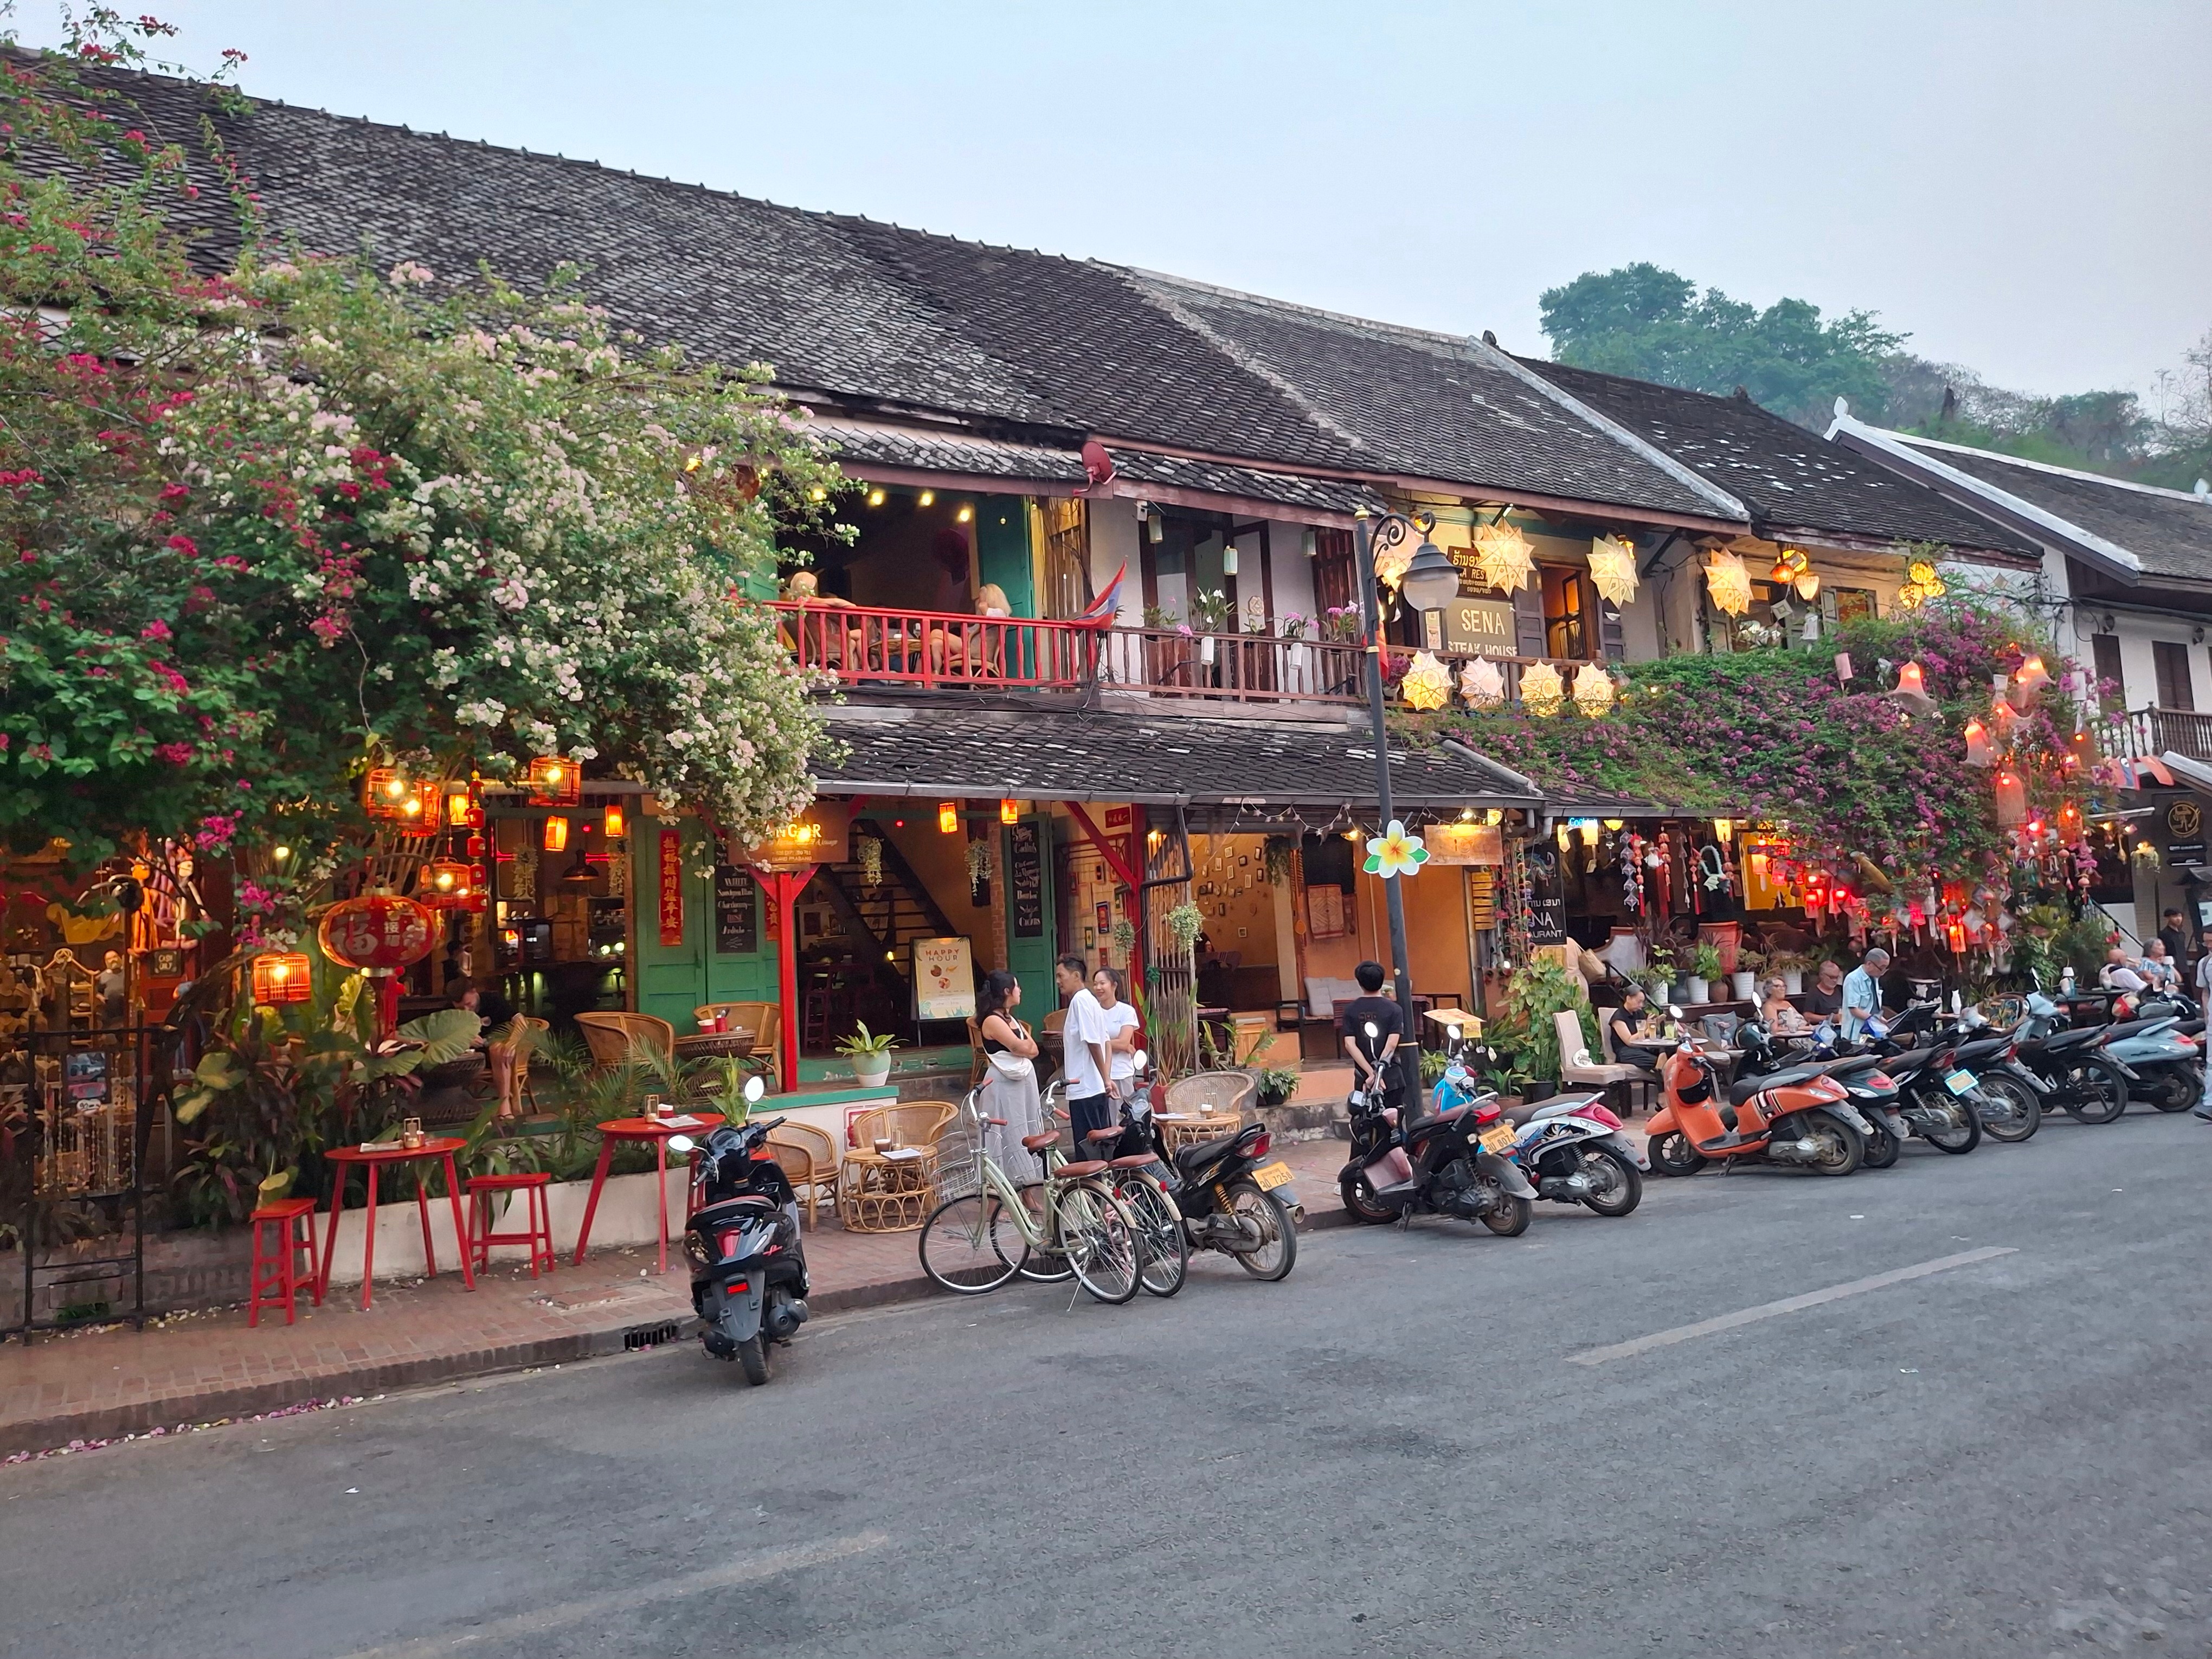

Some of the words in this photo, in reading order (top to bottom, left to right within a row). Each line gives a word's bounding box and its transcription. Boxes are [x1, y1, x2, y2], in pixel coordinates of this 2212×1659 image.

[1461, 608, 1506, 635] SENA
[1448, 641, 1481, 654] STEAK
[1484, 644, 1517, 657] HOUSE
[1532, 911, 1556, 930] NA
[1497, 1133, 1517, 1147] 8071
